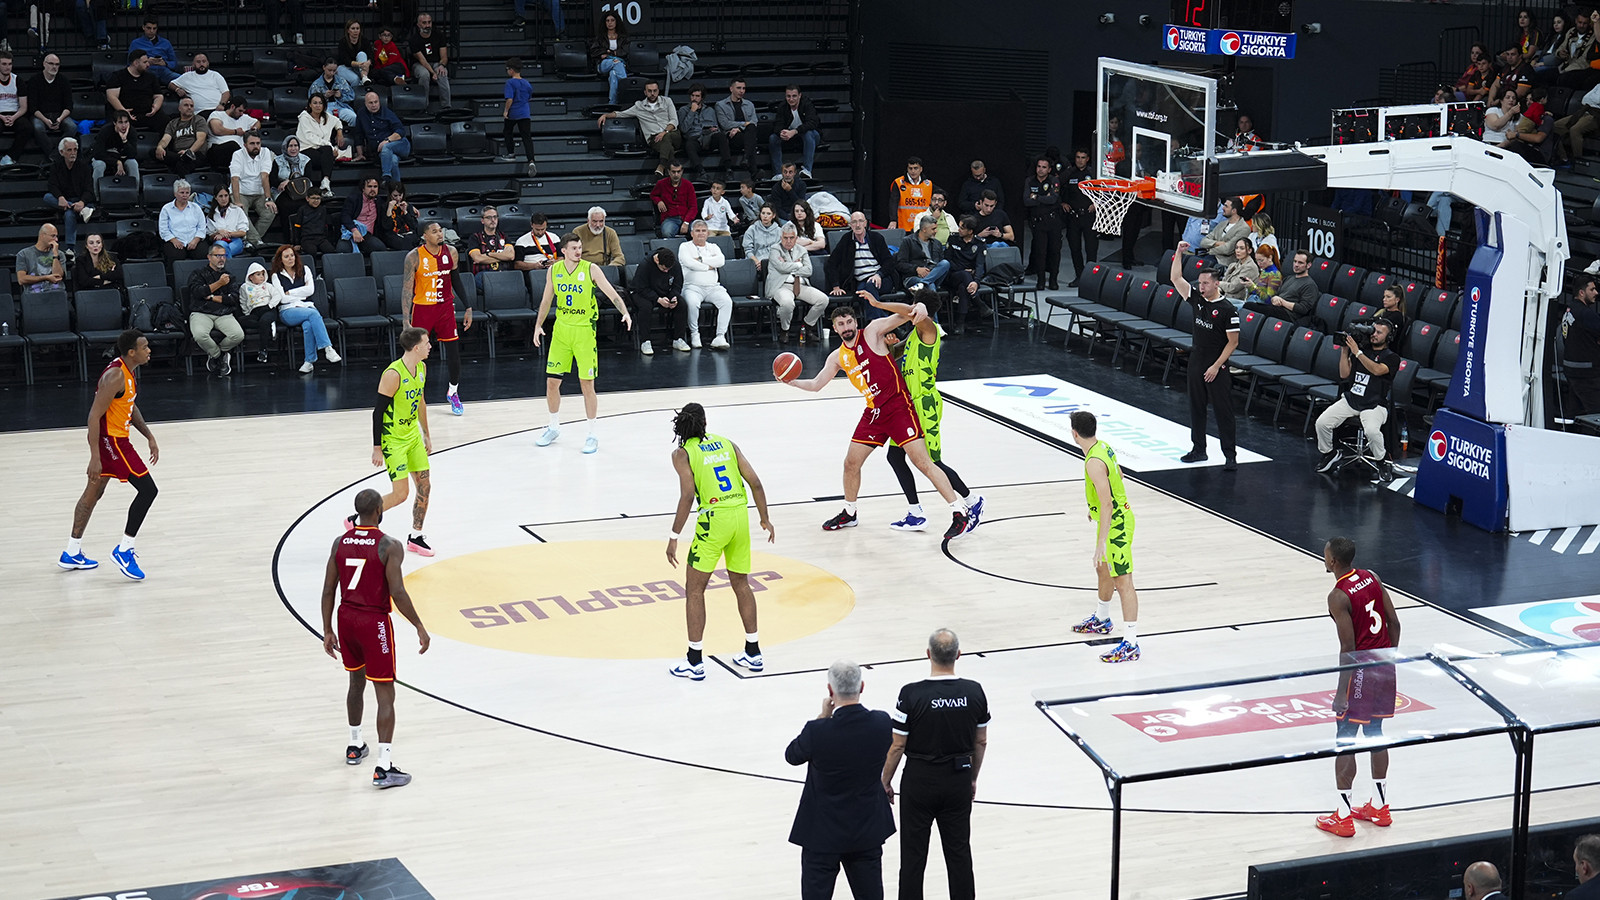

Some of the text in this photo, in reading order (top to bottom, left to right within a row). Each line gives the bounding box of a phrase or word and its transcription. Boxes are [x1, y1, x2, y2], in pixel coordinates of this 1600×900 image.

[1306, 228, 1335, 259] 108
[431, 277, 444, 289] 12
[565, 294, 573, 306] 8
[856, 369, 871, 387] 77
[697, 441, 724, 453] WHALEY
[703, 451, 732, 466] AYGAZ
[1446, 451, 1490, 480] SİGORTA
[713, 465, 733, 492] 5
[342, 537, 376, 546] CUMMINGS
[345, 557, 367, 590] 7
[1364, 599, 1383, 635] 3
